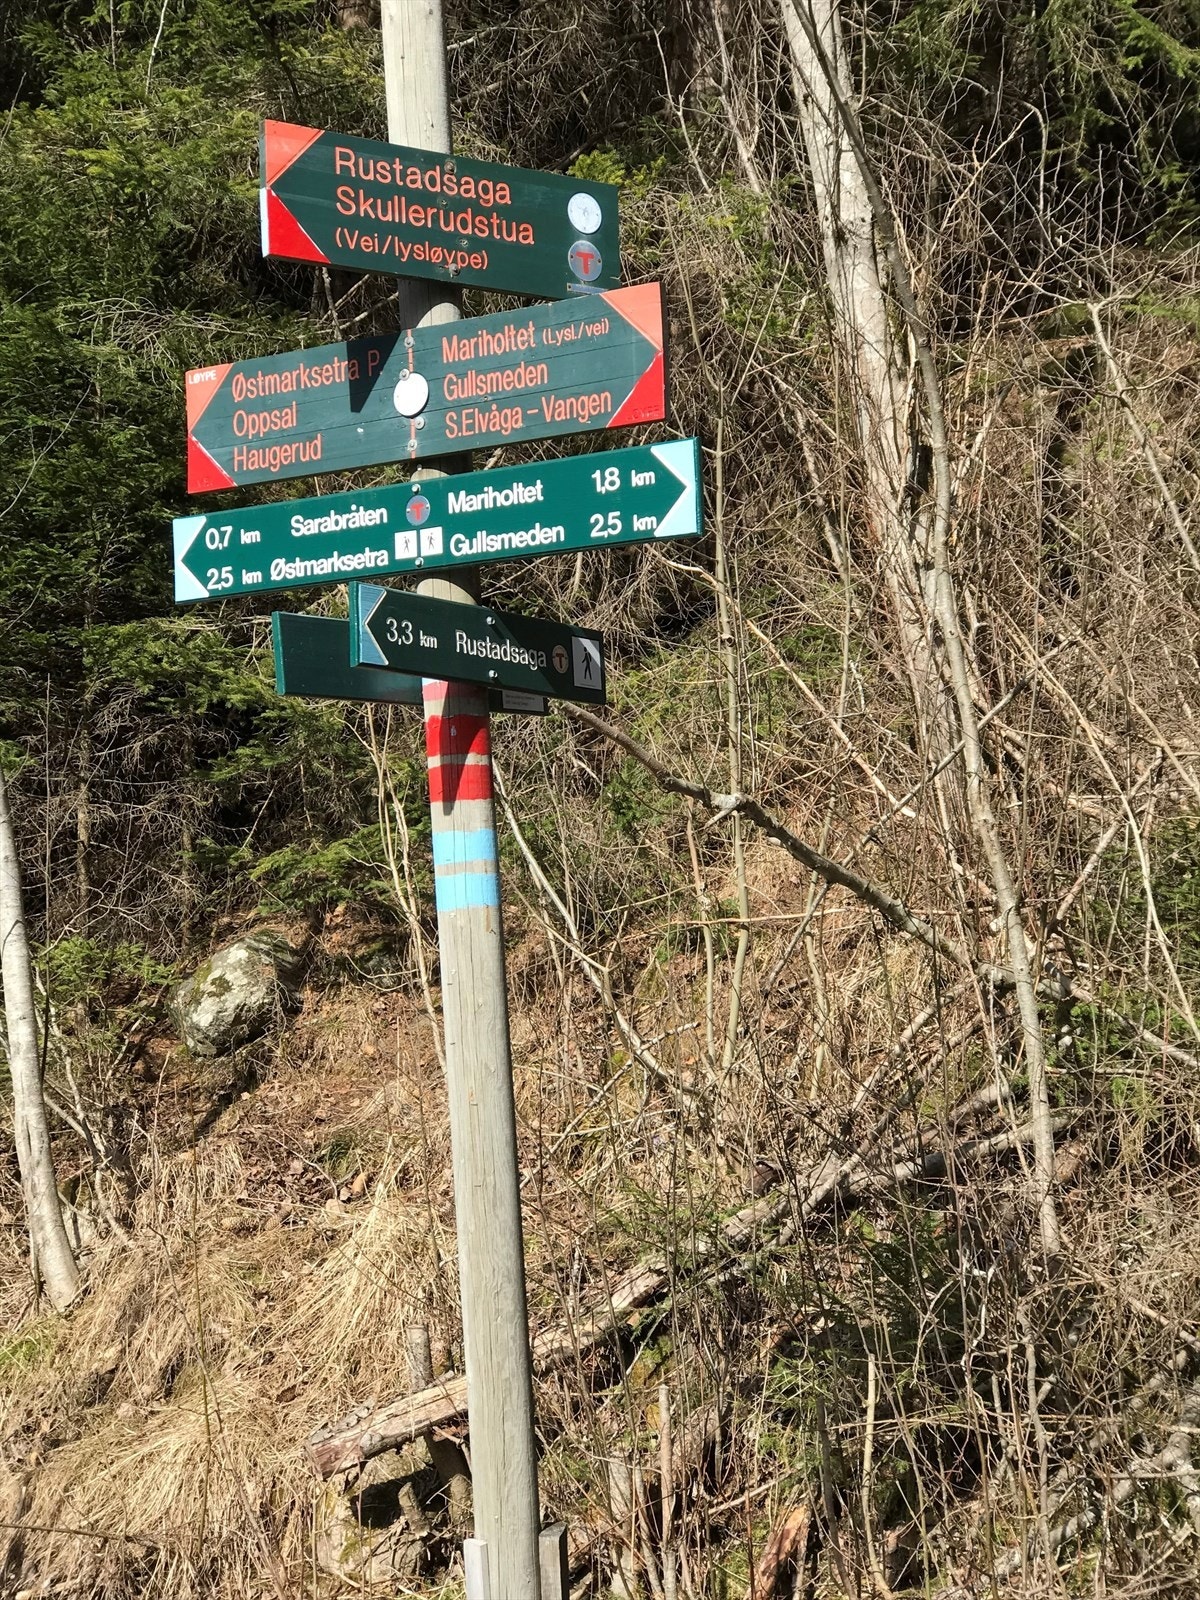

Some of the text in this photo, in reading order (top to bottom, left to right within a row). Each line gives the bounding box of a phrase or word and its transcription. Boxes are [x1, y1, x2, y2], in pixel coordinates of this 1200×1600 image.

[335, 146, 512, 208] Rustadsaga
[335, 184, 535, 245] Skullerudstua
[576, 251, 595, 275] T
[442, 318, 610, 364] Mariholtet (Lysl./vei)
[188, 370, 217, 384] LØYPE
[231, 349, 380, 403] Østmarksetra P
[444, 361, 548, 401] Gullsmeden
[233, 401, 297, 439] Oppsal
[233, 433, 322, 472] Haugerud
[410, 502, 425, 521] T
[447, 467, 656, 514] Mariholtet 1,8 km
[205, 504, 388, 550] 0,7 km Sarabråten
[450, 511, 657, 557] Gullsmeden 2,5 km
[206, 546, 389, 590] 2,5 km Østmarksetra
[386, 616, 547, 671] 3,3 km Rustadsaga
